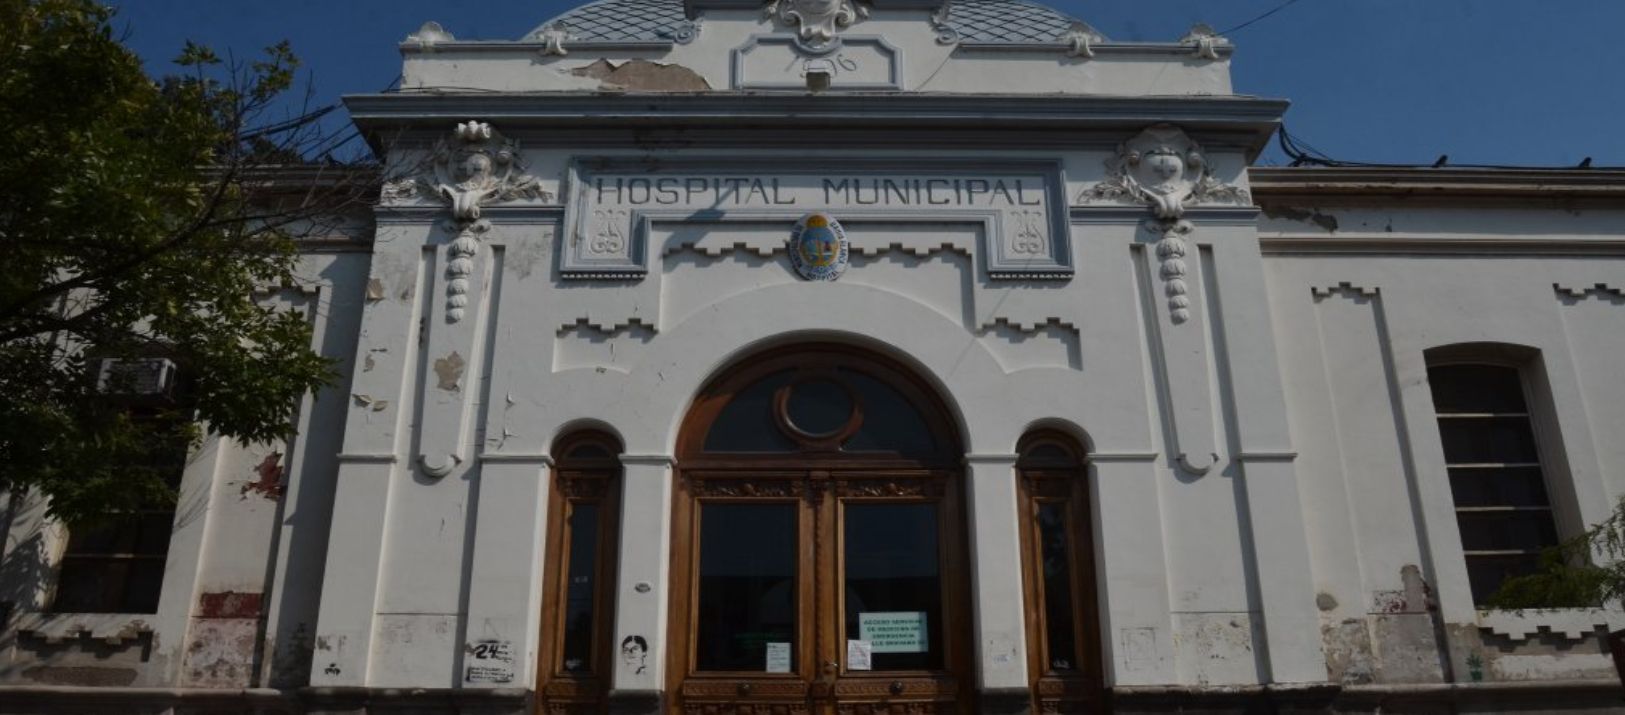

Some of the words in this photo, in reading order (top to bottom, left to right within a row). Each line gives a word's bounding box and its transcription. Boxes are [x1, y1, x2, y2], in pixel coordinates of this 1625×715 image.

[597, 177, 796, 205] HOSPITAL
[822, 178, 1040, 206] MUNICIPAL
[475, 643, 498, 659] 24
